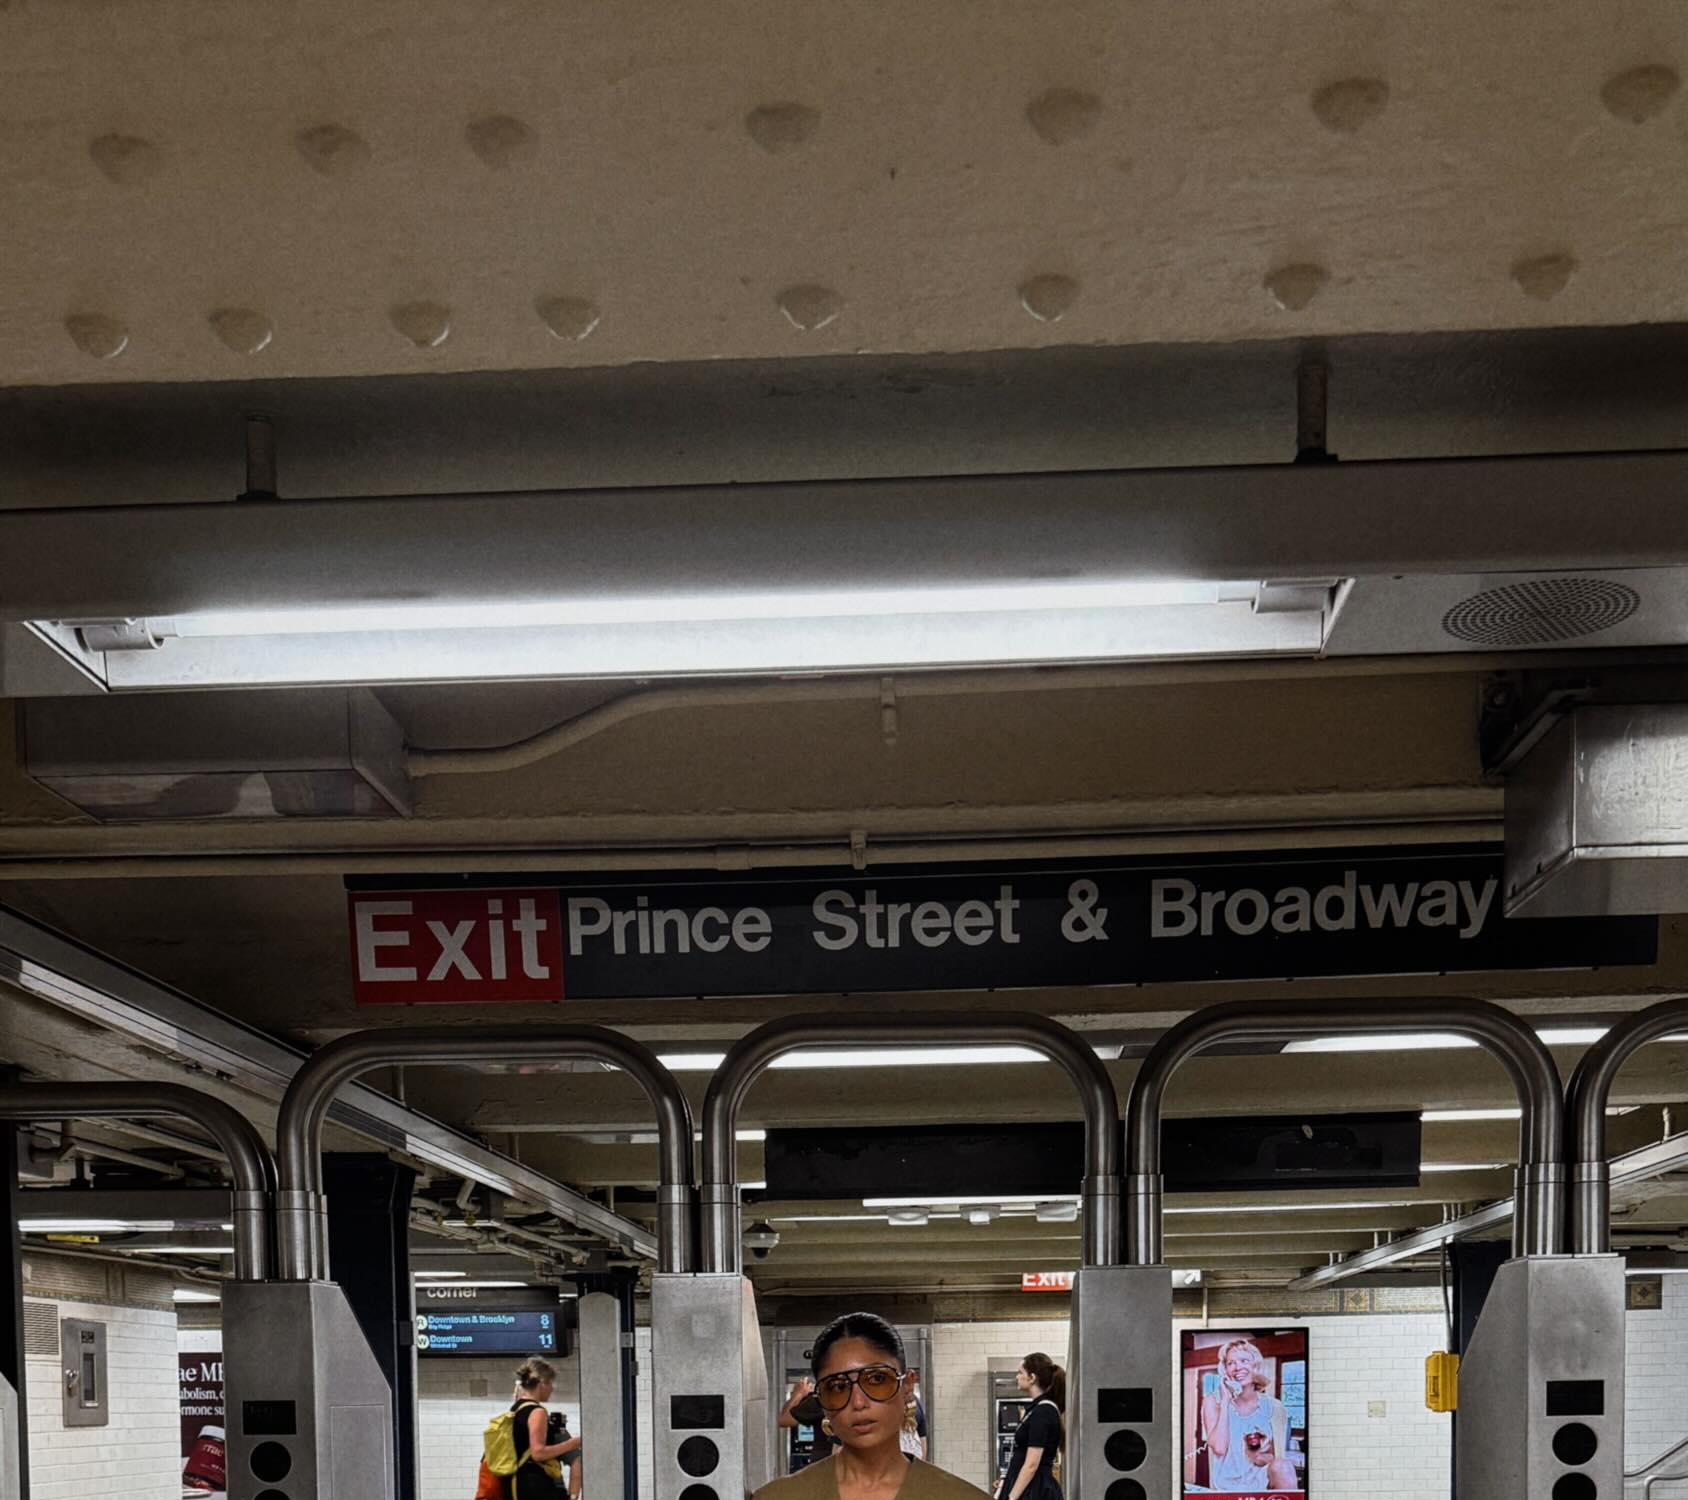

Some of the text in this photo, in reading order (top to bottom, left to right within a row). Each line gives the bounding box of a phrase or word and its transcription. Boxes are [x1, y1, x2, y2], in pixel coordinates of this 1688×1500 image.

[354, 871, 1499, 982] Exit Prince Street & Broadway
[428, 1315, 471, 1324] Downtown
[540, 1314, 550, 1326] 8
[430, 1335, 472, 1343] Downtown
[539, 1334, 553, 1345] 11
